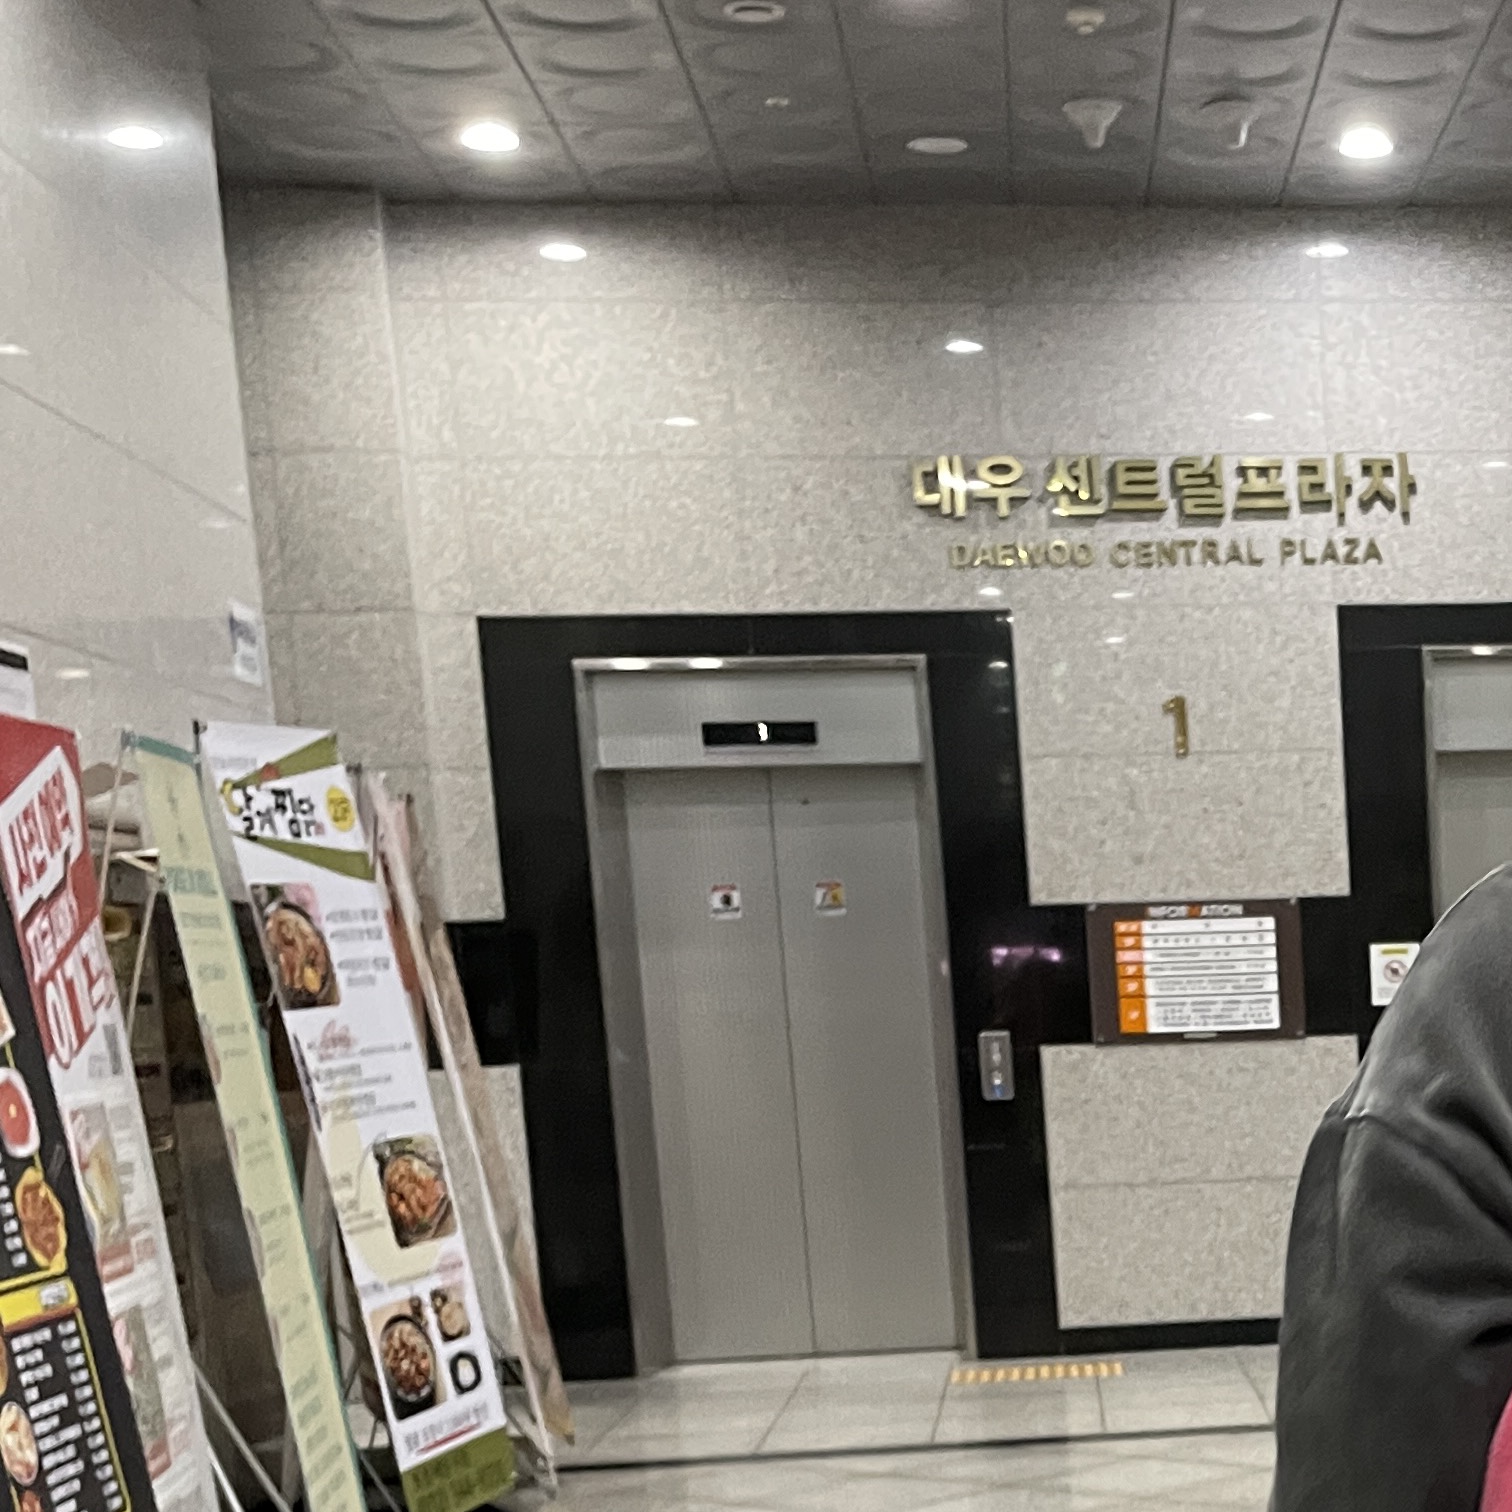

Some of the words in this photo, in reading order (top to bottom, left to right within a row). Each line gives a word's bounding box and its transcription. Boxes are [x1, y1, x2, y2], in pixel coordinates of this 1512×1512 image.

[912, 454, 1031, 518] 대우
[1046, 452, 1417, 527] 센트럴프라자
[949, 539, 1094, 570] DAEWOO
[1110, 538, 1265, 568] CENTRAL
[1279, 537, 1384, 566] PLAZA
[1162, 696, 1189, 759] 1
